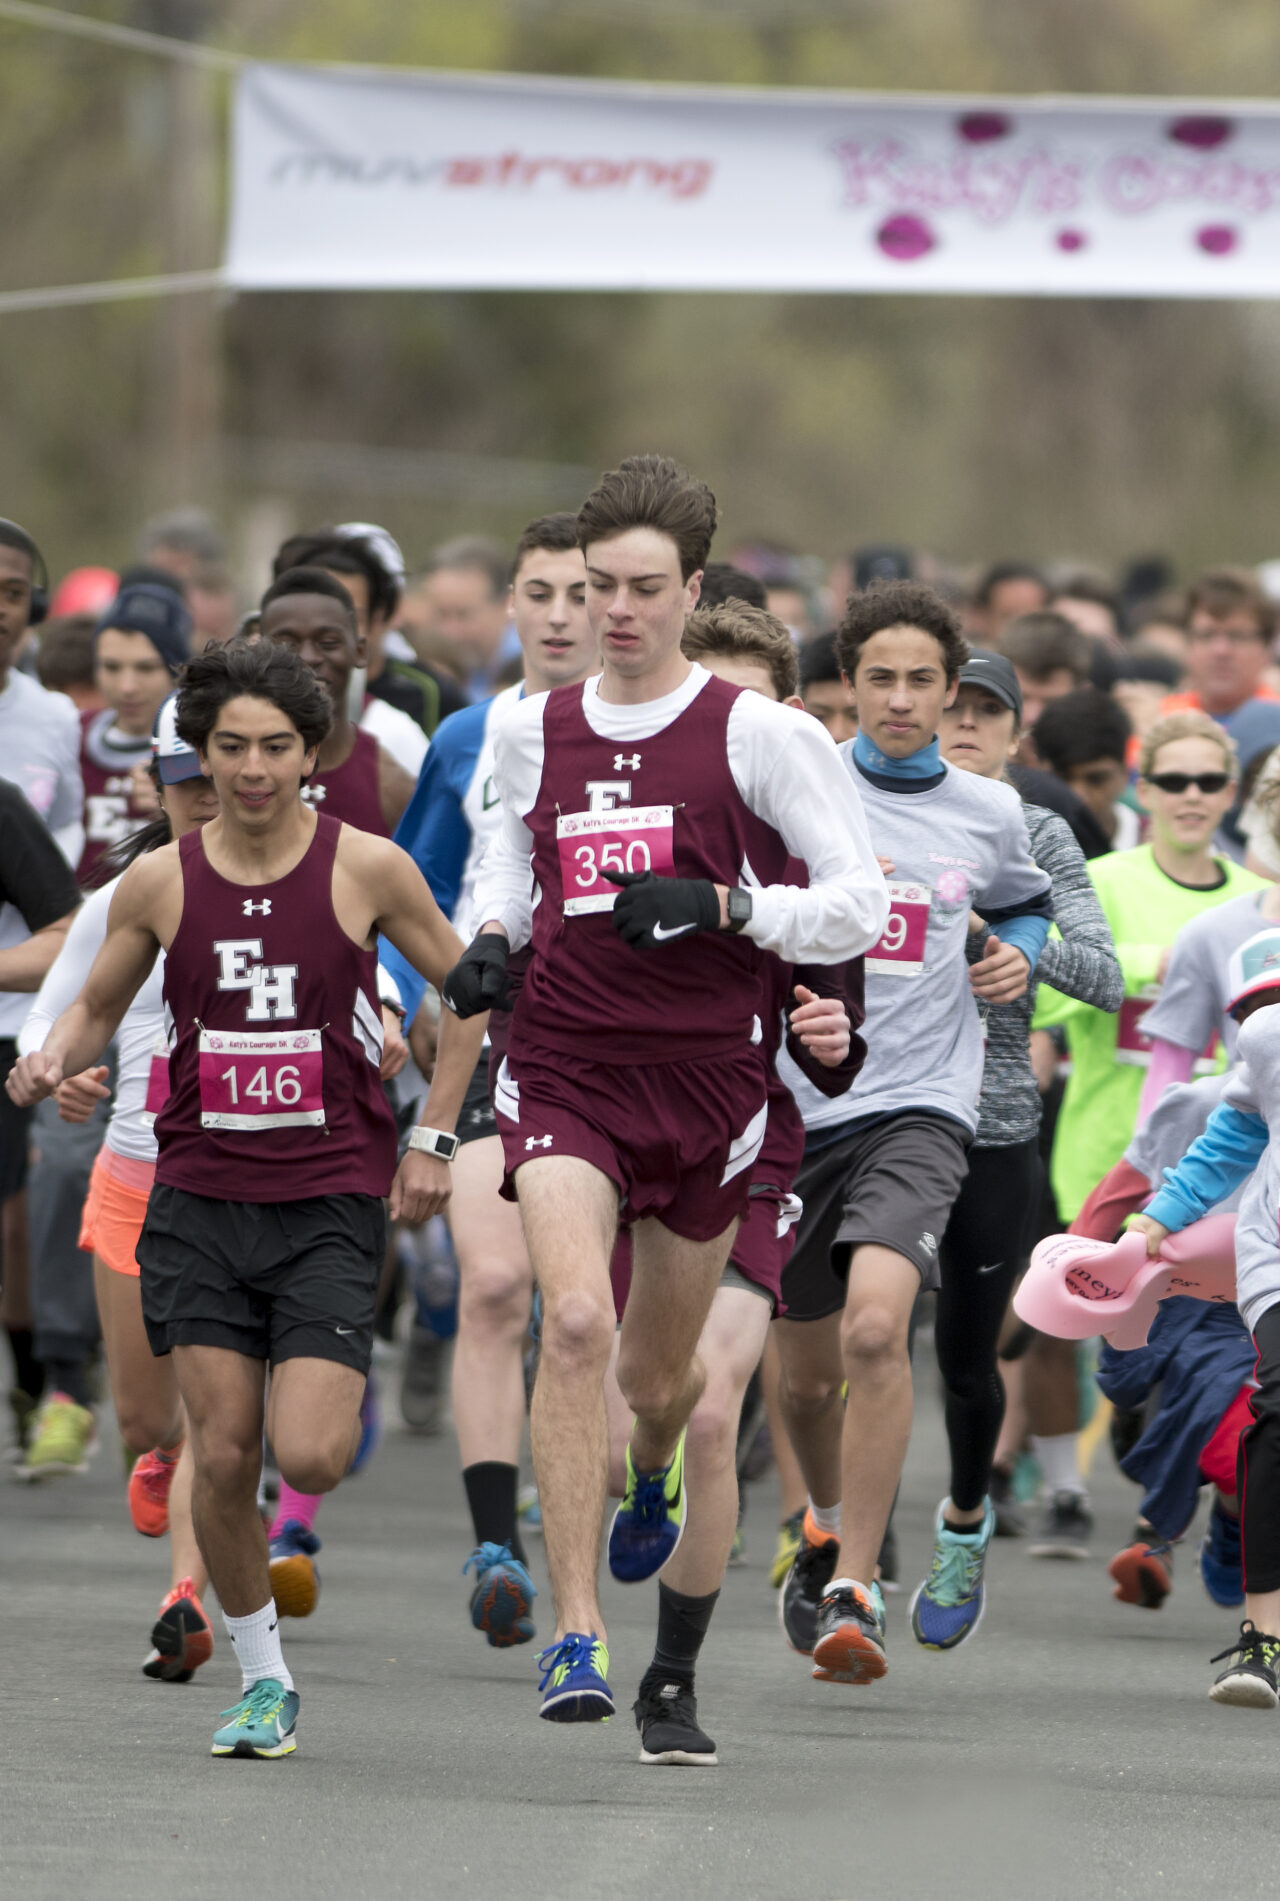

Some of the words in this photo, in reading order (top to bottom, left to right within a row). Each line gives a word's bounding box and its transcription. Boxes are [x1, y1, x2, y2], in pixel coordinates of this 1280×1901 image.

[574, 840, 651, 887] 350
[213, 938, 298, 1021] EH
[229, 1040, 248, 1049] Katy's
[249, 1041, 277, 1049] Courage
[221, 1065, 302, 1105] 146
